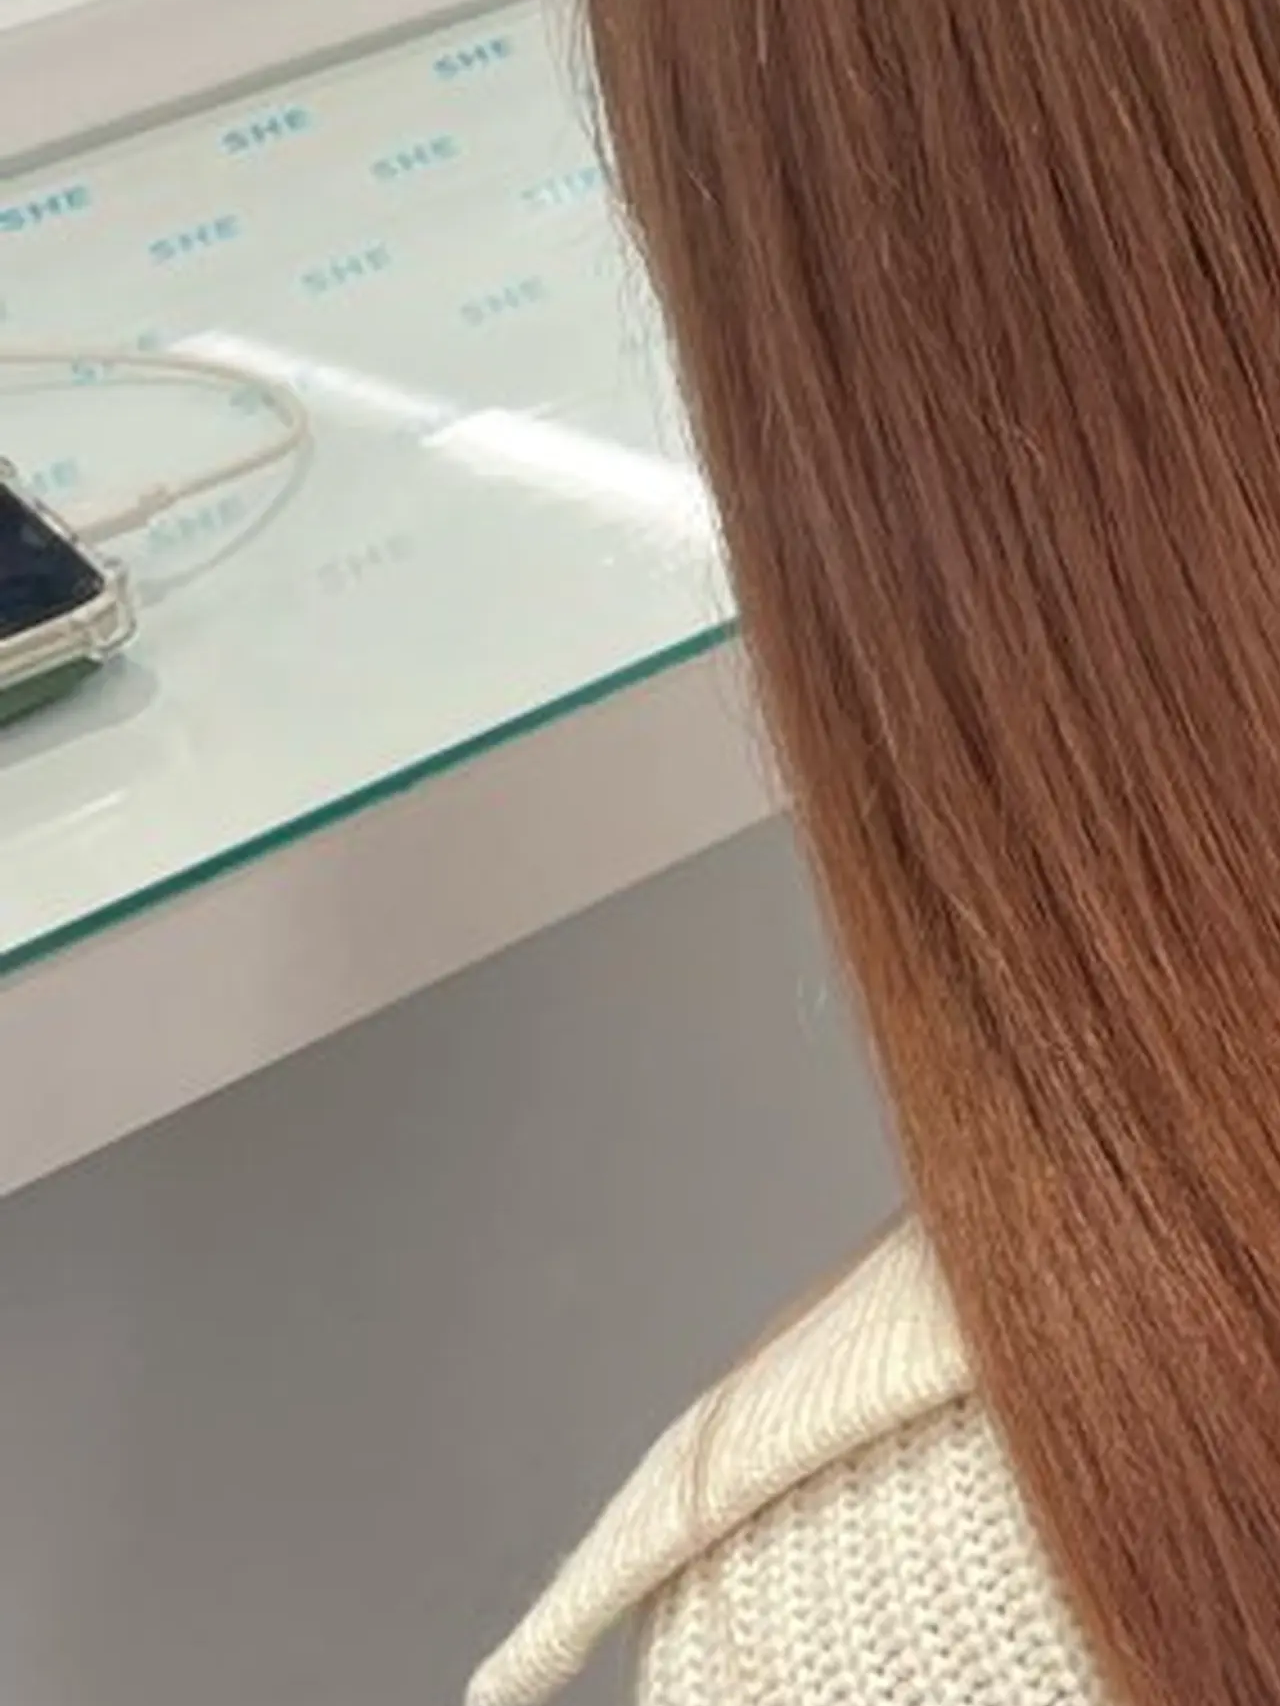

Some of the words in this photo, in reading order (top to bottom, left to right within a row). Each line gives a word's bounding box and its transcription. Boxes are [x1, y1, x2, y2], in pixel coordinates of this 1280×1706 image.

[433, 37, 512, 79] SHE
[220, 106, 309, 155] SHE
[370, 134, 461, 181] SHE
[0, 185, 90, 232] SHE
[149, 213, 242, 264] SHE
[302, 243, 393, 294] SHE
[460, 277, 545, 328] SHE
